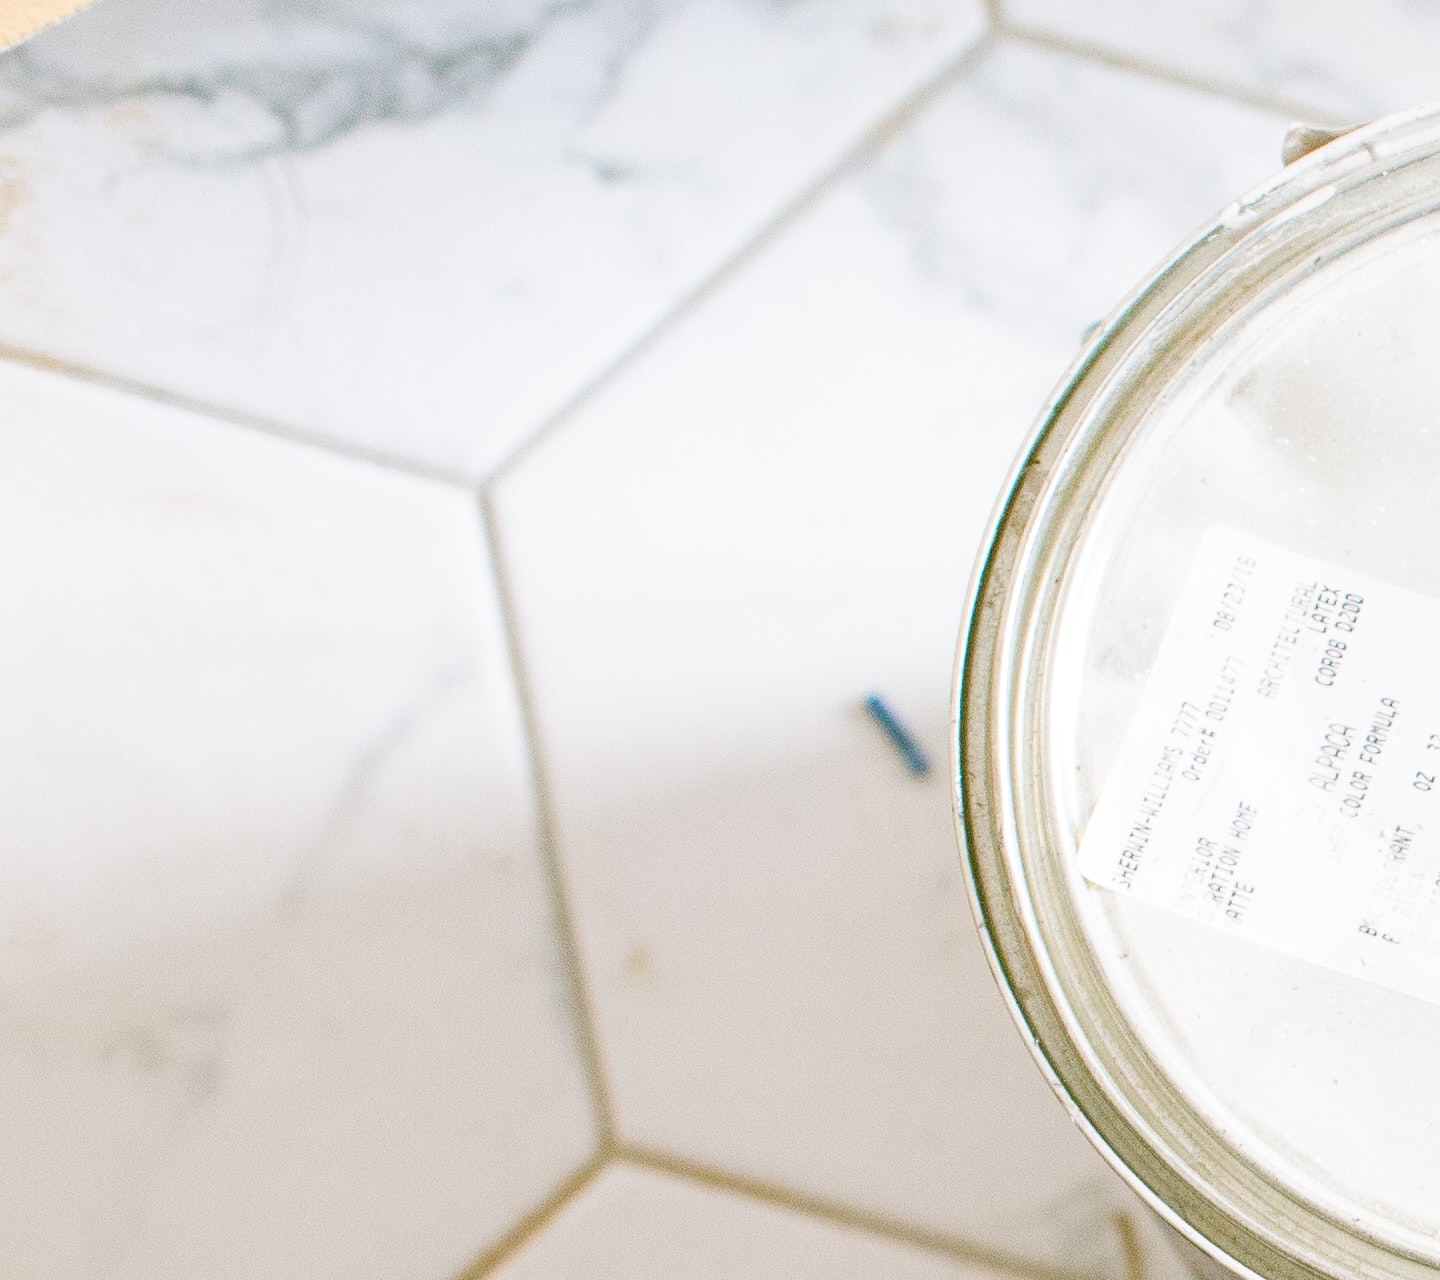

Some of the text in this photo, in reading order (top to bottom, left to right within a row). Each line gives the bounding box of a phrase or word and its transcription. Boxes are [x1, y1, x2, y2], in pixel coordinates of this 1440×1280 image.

[1255, 581, 1318, 697] ARCHITECTURAL
[1312, 638, 1347, 687] COROB
[1204, 653, 1244, 723] 0011477
[1230, 800, 1257, 839] HOME
[1309, 584, 1341, 634] LATEX
[1307, 722, 1355, 791] ALPACA
[1358, 696, 1399, 765] FORMULA
[1111, 745, 1183, 889] SHERWIN-WILLIAMS
[1169, 700, 1200, 737] 7777
[1411, 770, 1436, 792] OZ
